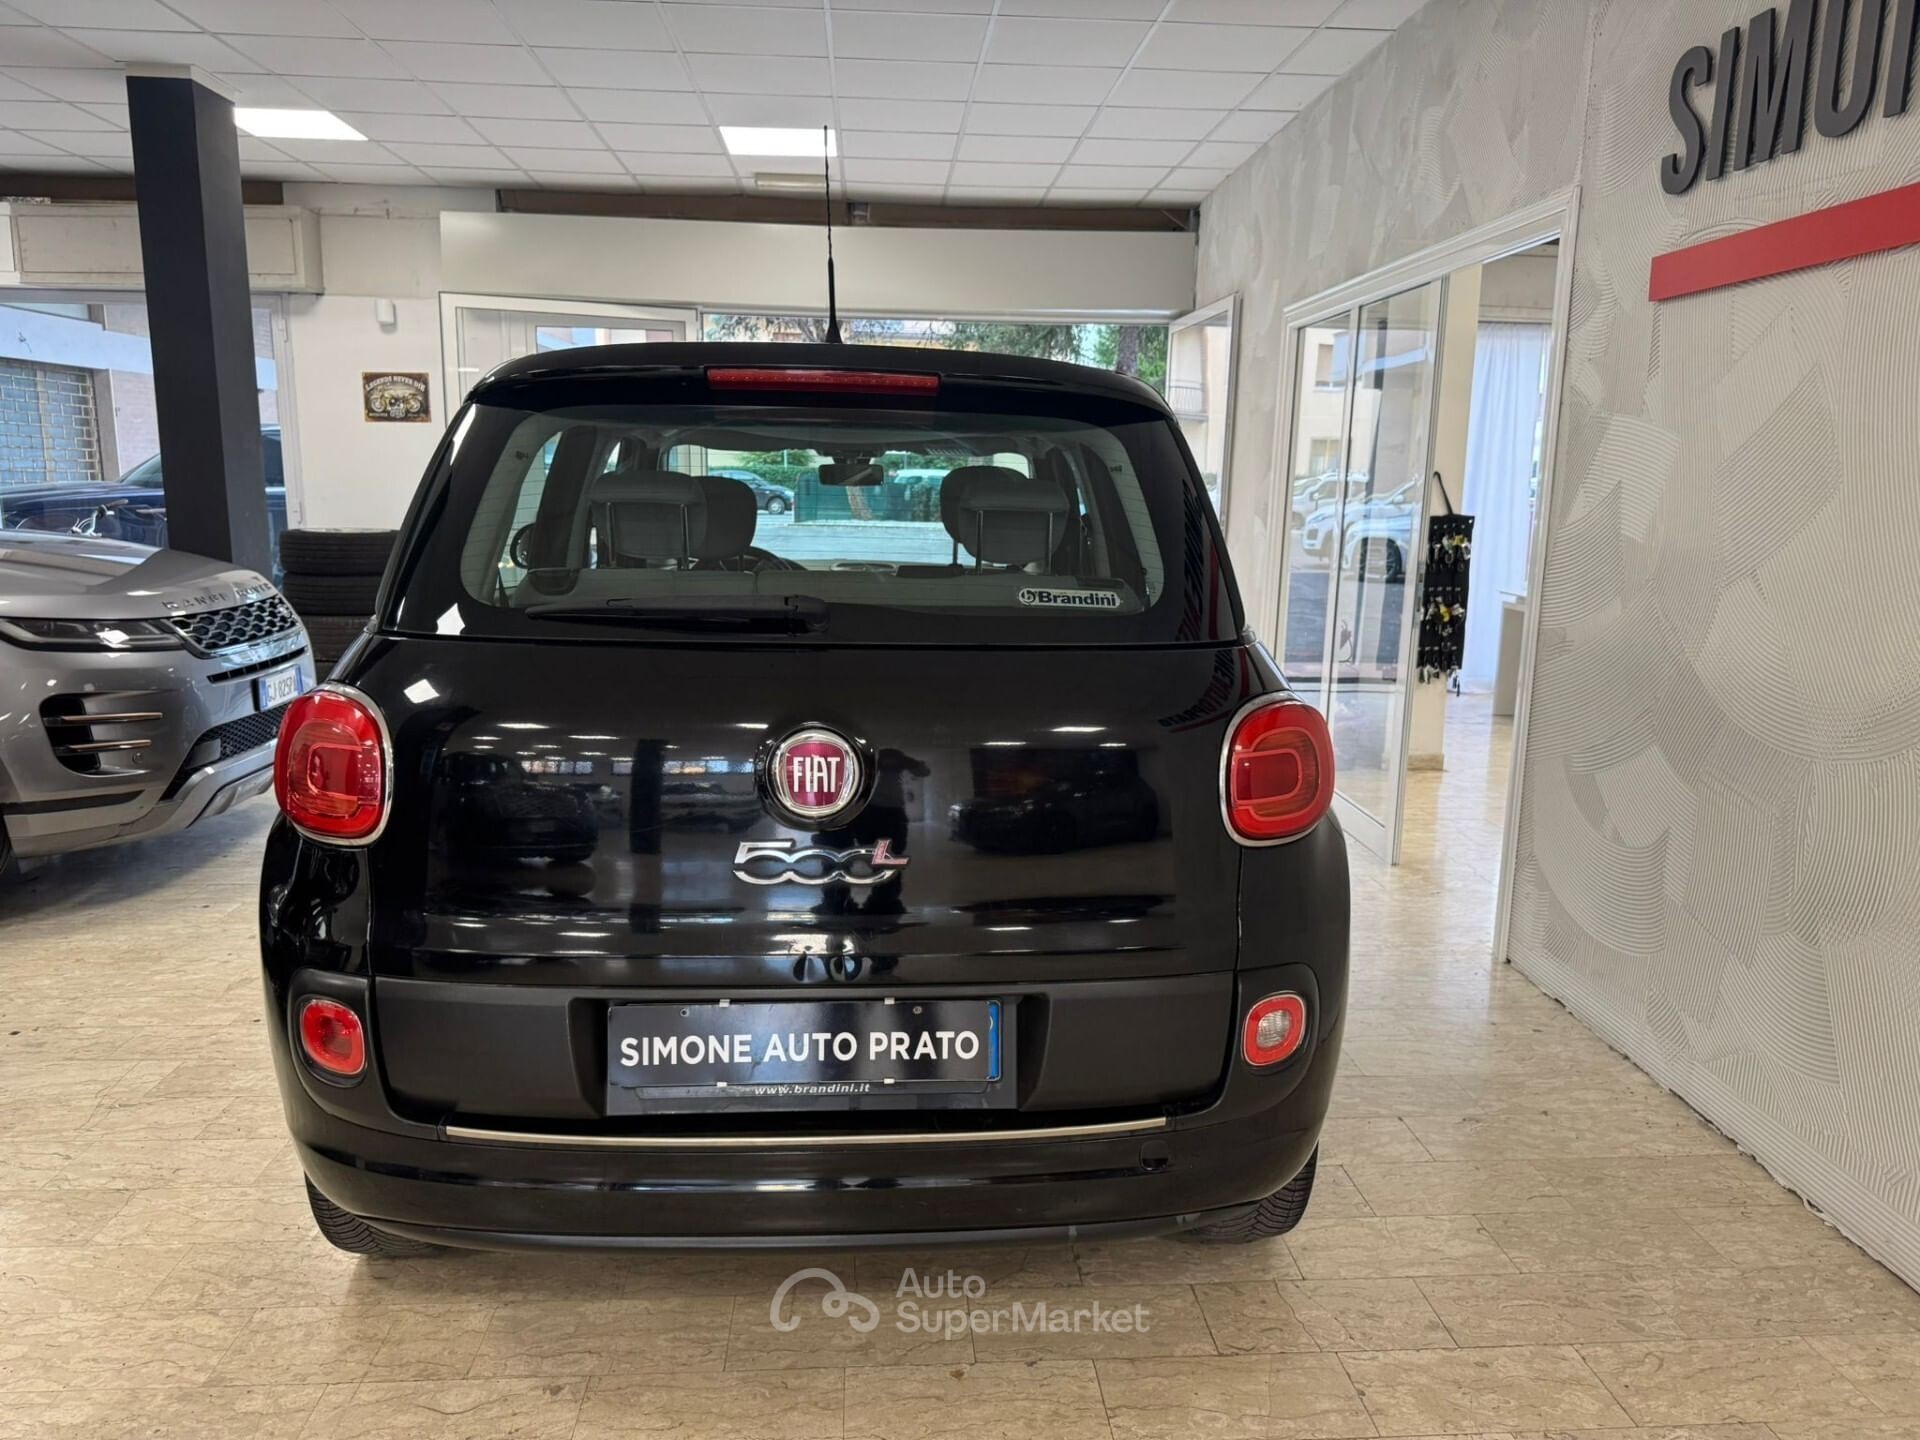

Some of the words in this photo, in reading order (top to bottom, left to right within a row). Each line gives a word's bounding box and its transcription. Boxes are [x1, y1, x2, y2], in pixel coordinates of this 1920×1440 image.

[1660, 0, 1920, 194] SIMO
[1038, 590, 1116, 607] Brandini
[793, 757, 840, 792] FIAT
[733, 839, 909, 885] 500L
[620, 1033, 752, 1066] SIMONE
[763, 1032, 858, 1063] AUTO
[869, 1030, 980, 1060] PRATO
[754, 1083, 870, 1096] www.brandini.it
